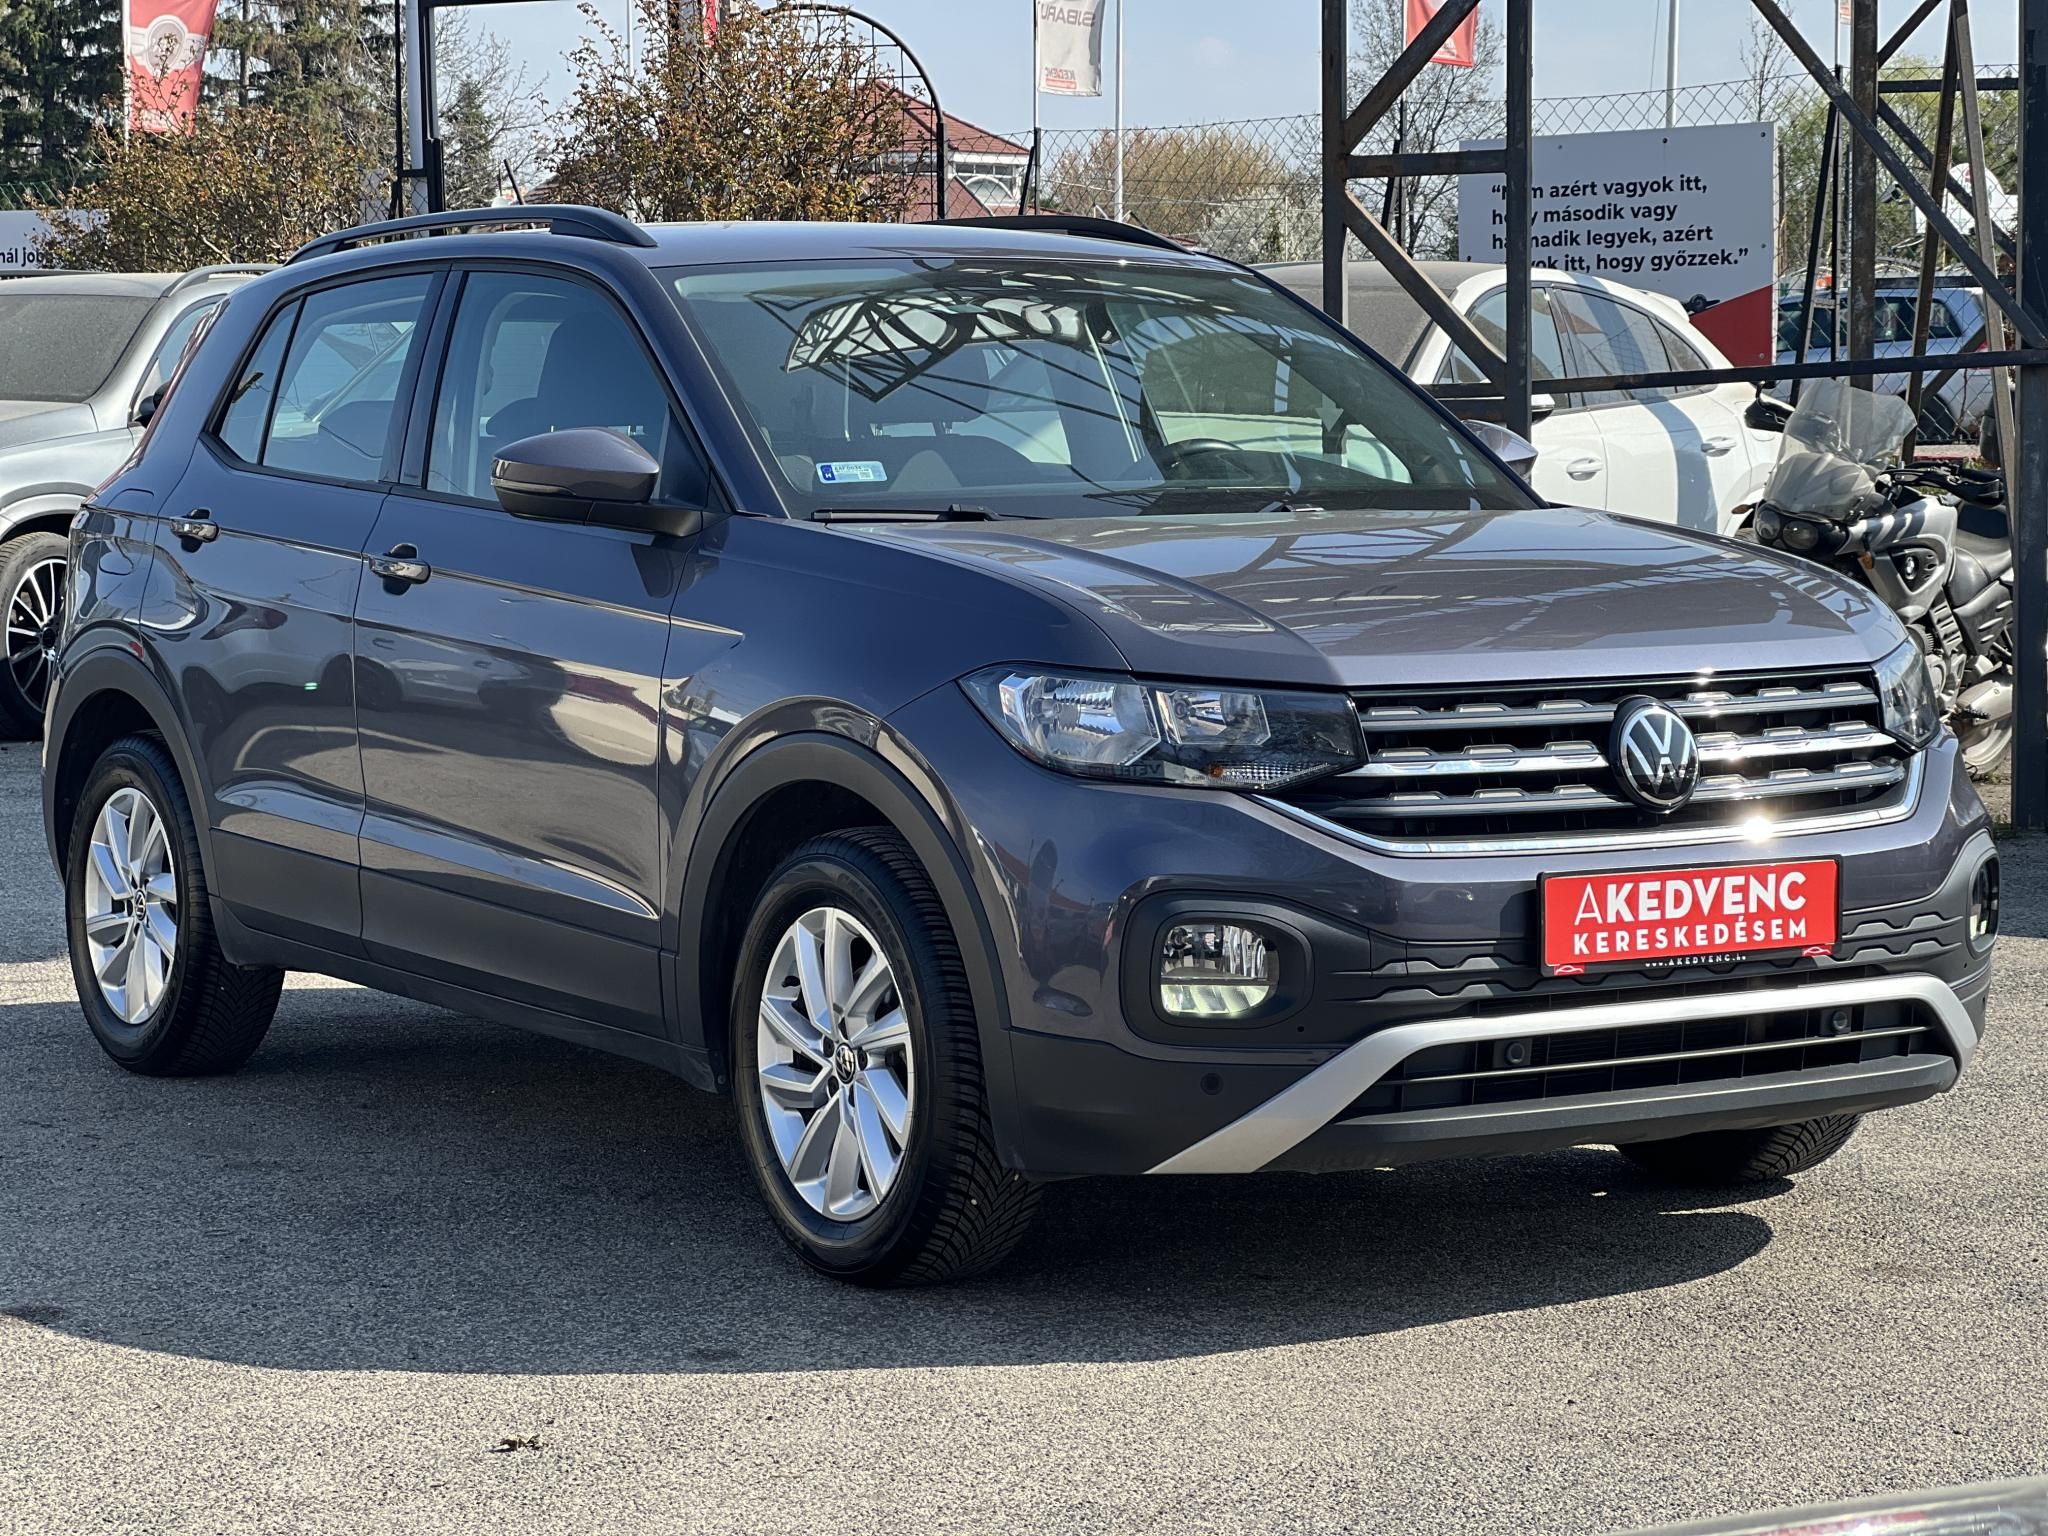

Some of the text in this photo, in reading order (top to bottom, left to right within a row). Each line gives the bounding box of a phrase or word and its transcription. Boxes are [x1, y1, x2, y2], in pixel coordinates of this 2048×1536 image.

[1550, 180, 1597, 198] azért
[1603, 176, 1674, 197] vagyok
[1680, 174, 1707, 194] itt,
[1543, 203, 1625, 223] második
[1630, 204, 1678, 221] vagy
[1586, 227, 1657, 249] legyek,
[1663, 224, 1713, 242] azért
[1564, 254, 1590, 273] itt,
[1596, 254, 1645, 273] hogy
[1650, 248, 1748, 271] győzzek.”
[1574, 871, 1807, 926] AKEDVENC
[1573, 916, 1807, 955] KERESKEDÉSEM
